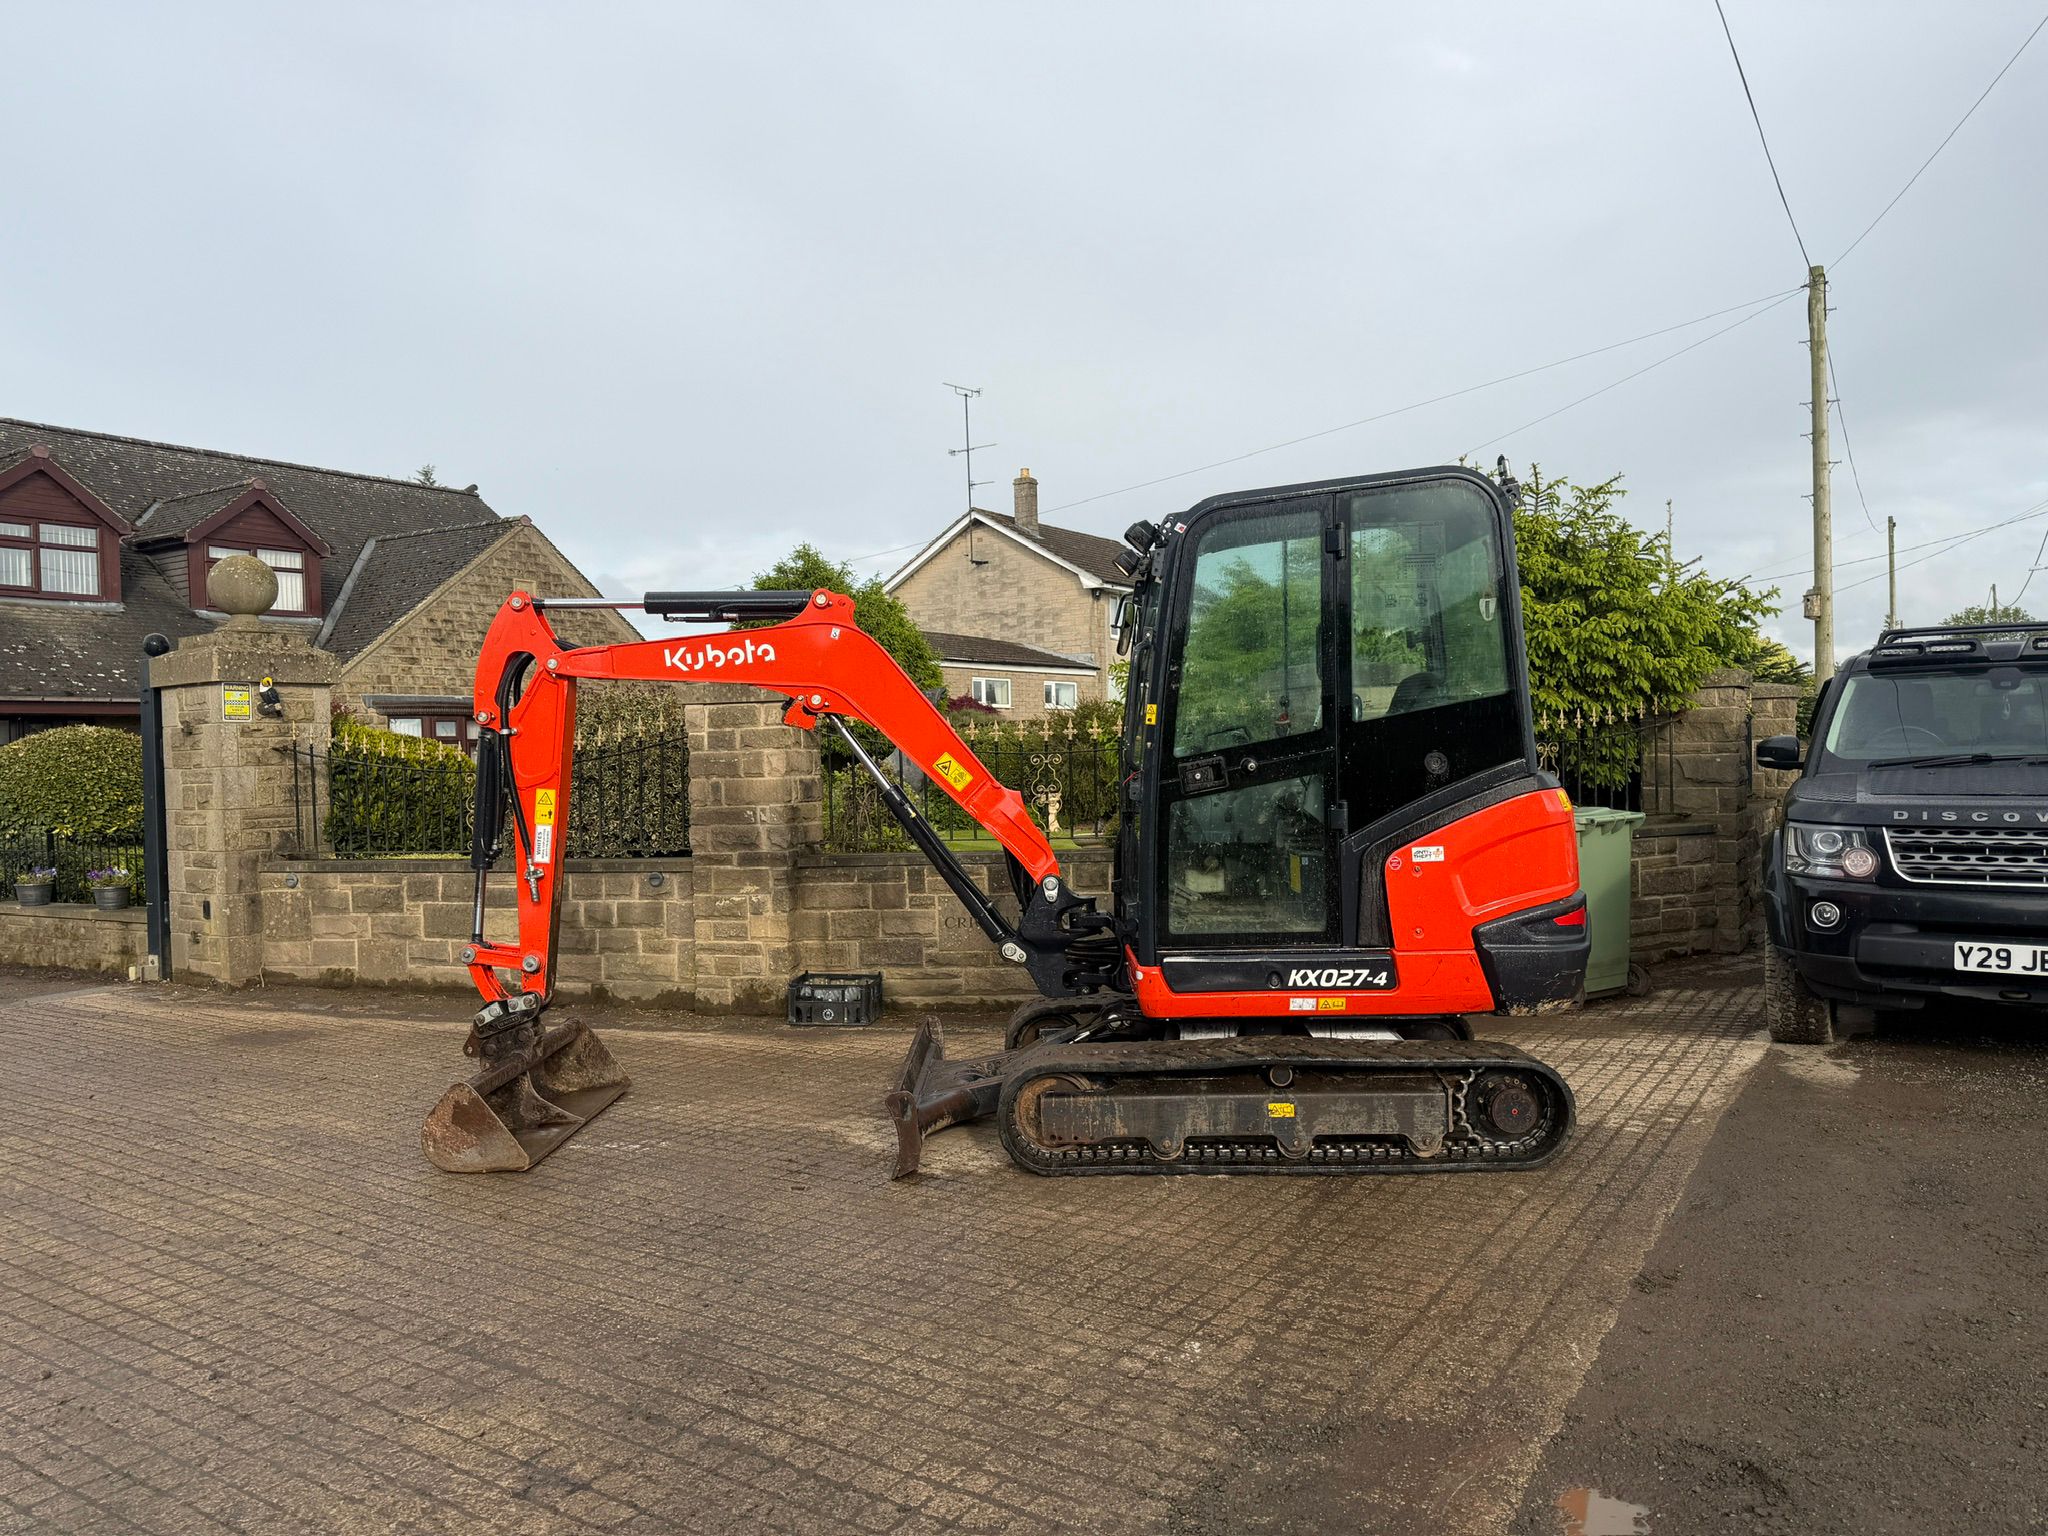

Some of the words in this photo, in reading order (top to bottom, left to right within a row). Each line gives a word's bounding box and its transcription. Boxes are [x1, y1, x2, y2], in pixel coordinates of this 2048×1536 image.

[664, 639, 776, 672] Kubota
[1958, 945, 2012, 970] Y29
[1287, 968, 1388, 987] KX027-4
